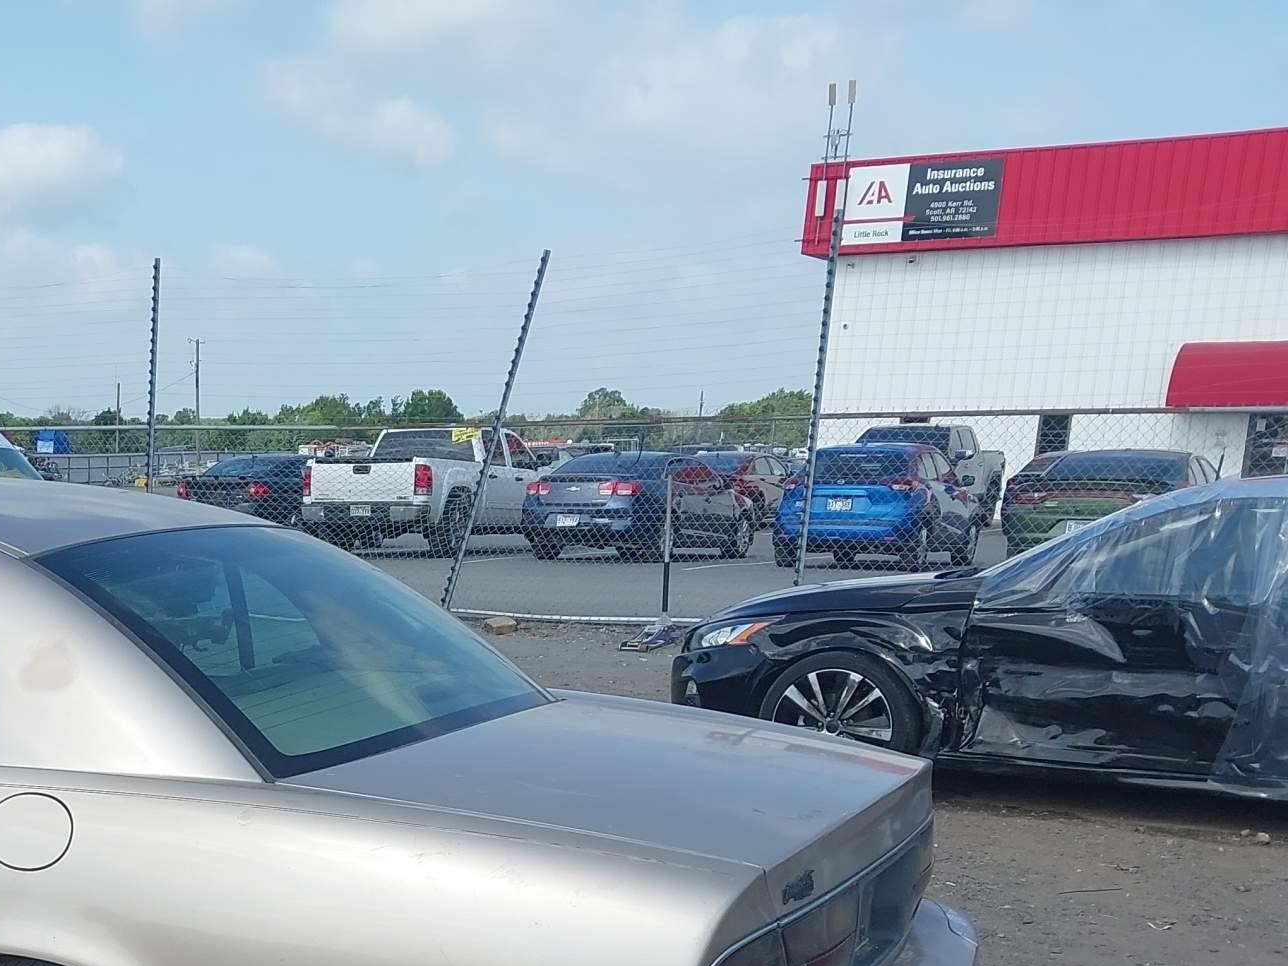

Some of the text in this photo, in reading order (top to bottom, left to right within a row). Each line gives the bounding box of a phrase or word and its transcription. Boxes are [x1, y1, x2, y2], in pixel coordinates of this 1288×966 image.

[926, 166, 985, 180] Insurance
[912, 179, 995, 195] Auto Auctions
